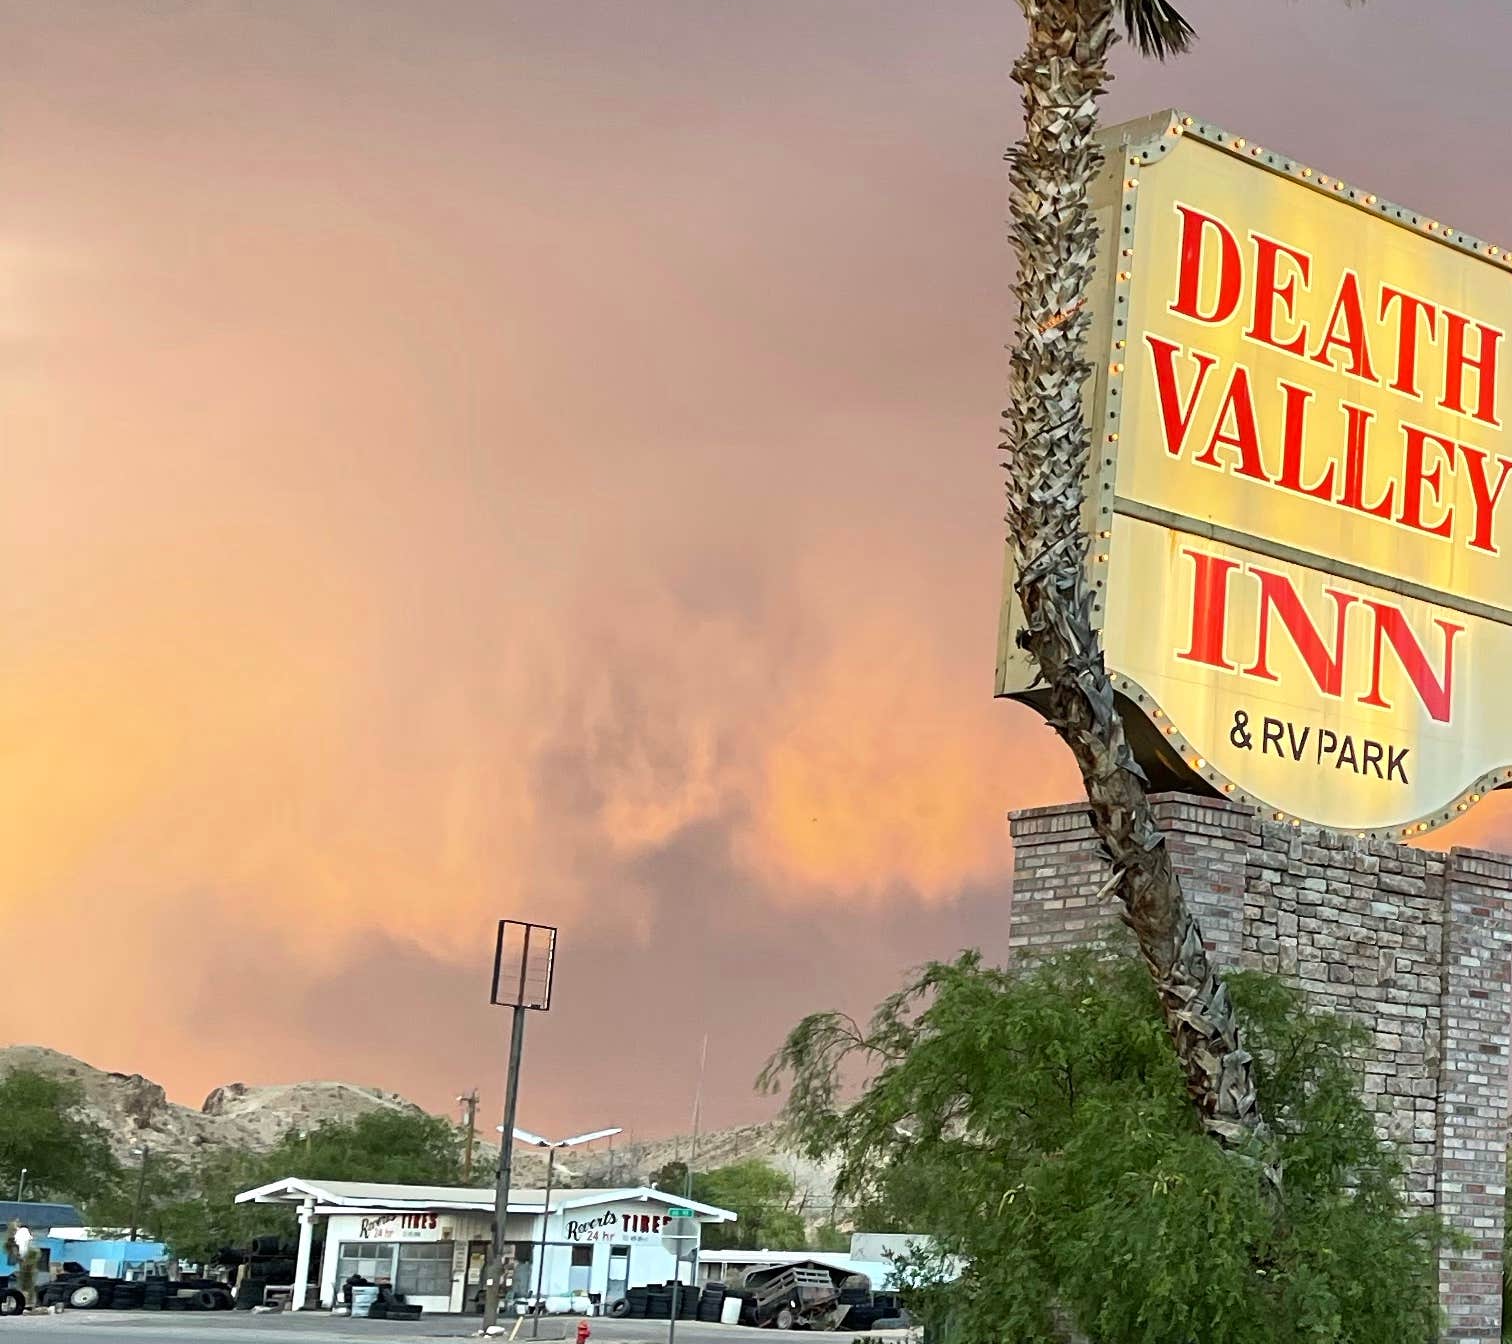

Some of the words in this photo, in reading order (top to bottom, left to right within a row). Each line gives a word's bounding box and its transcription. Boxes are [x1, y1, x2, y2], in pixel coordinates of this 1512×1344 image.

[1169, 202, 1504, 427] DEATH
[1177, 550, 1465, 722] INN
[1230, 710, 1253, 751] &
[1262, 716, 1310, 762] RV
[1317, 728, 1410, 785] PARK
[587, 1230, 599, 1241] 24
[602, 1231, 615, 1241] hr
